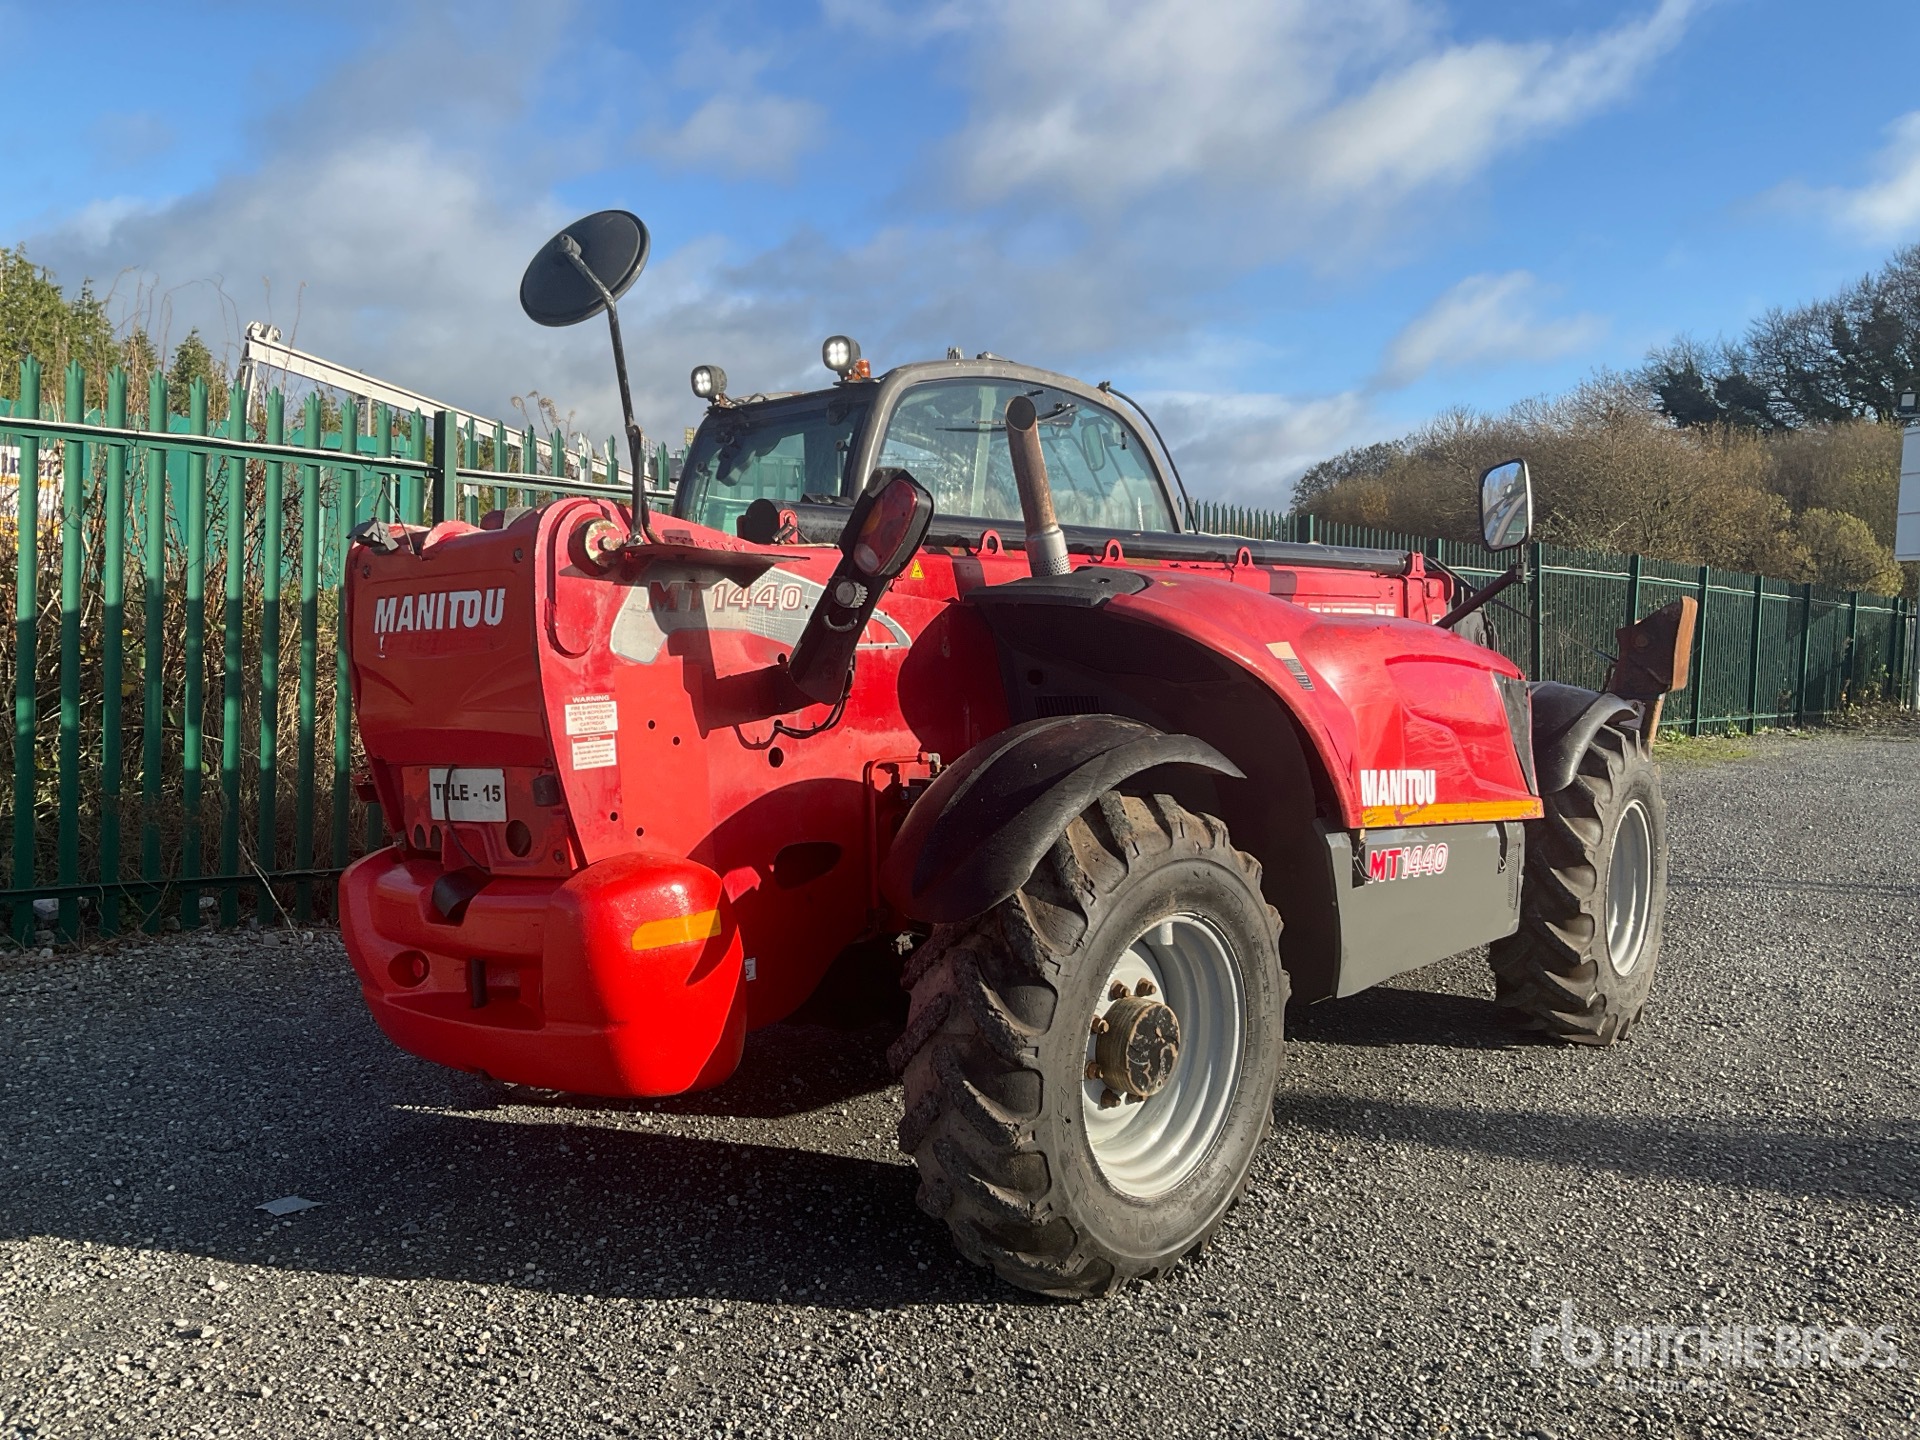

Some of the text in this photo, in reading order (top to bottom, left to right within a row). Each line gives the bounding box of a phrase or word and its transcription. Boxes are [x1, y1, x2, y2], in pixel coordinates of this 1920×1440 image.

[374, 588, 506, 634] MANITOU
[646, 580, 802, 613] MT1440
[572, 695, 609, 703] WARNING
[483, 784, 501, 803] 15
[1360, 769, 1436, 807] MANITOU
[1367, 842, 1448, 884] MT1440
